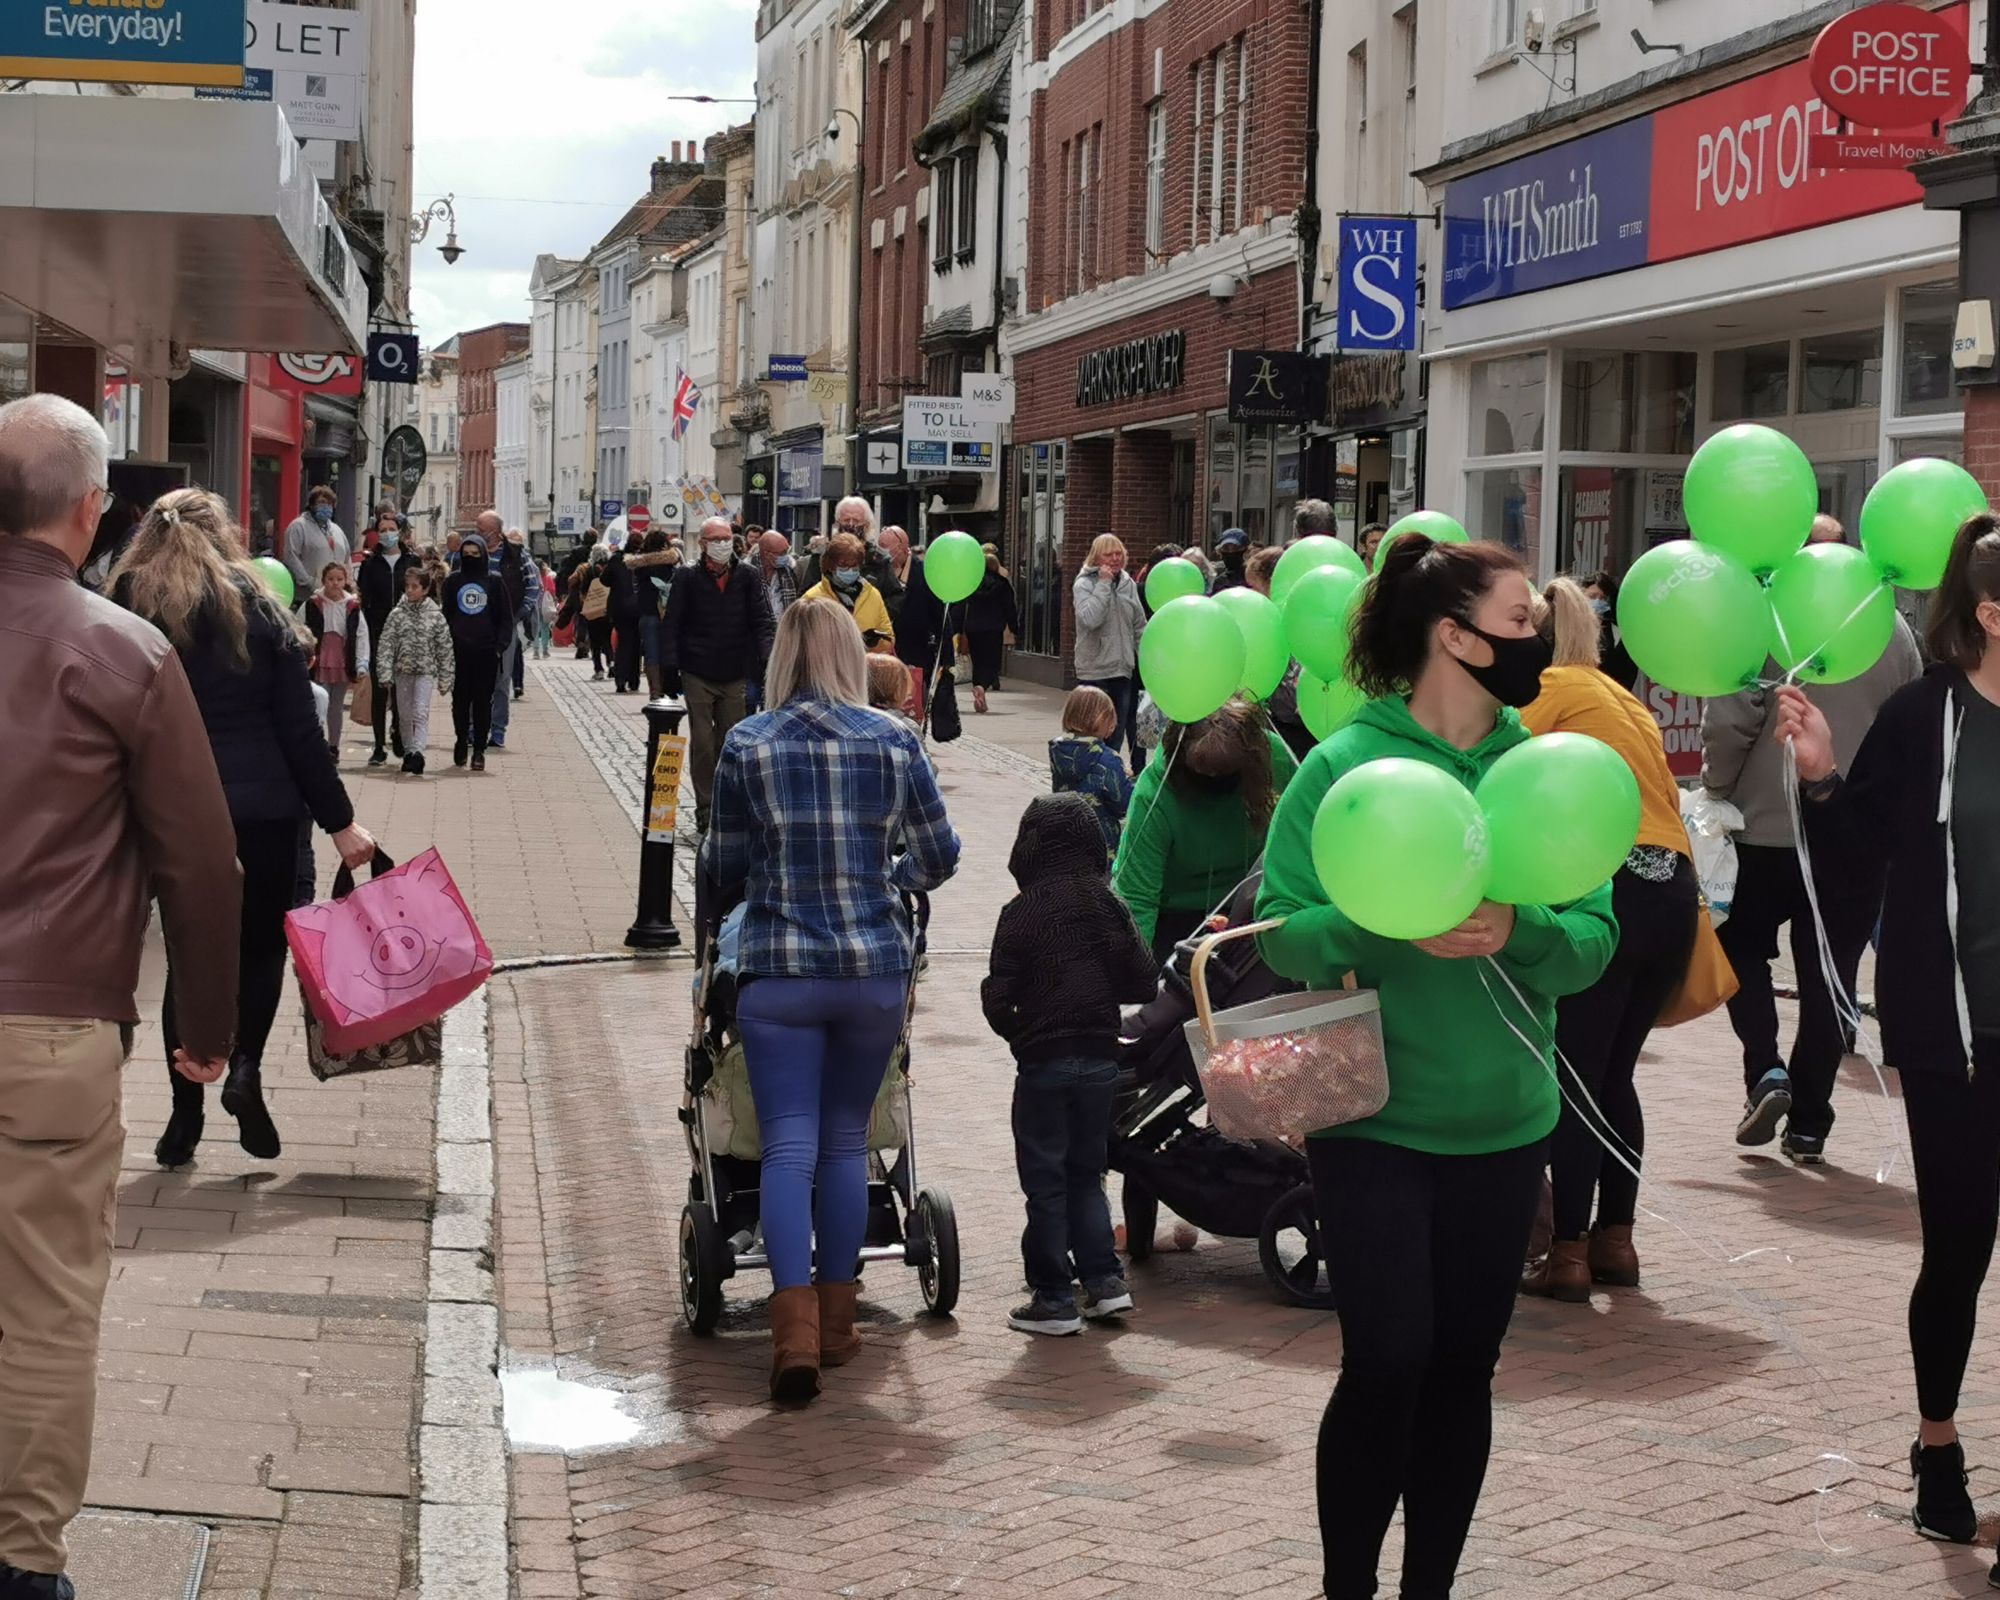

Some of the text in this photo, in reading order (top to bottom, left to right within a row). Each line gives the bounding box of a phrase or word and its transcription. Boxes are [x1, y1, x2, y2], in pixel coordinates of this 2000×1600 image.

[44, 7, 183, 47] Everyday!
[275, 23, 350, 56] LET
[1852, 31, 1939, 61] POST
[1829, 65, 1950, 96] OFFICE
[315, 102, 340, 111] GUNN
[1696, 114, 1772, 211] POST
[1835, 141, 1884, 158] Travel
[1482, 163, 1599, 274] WHSmith
[1352, 228, 1404, 254] WH
[1351, 254, 1405, 341] S
[1122, 328, 1183, 398] SPENCER
[908, 401, 937, 410] FITTED
[973, 389, 1002, 402] M&S
[922, 412, 944, 426] TO
[927, 429, 974, 439] MAY SELL
[560, 504, 589, 514] TO LET
[1648, 685, 1699, 728] SA
[1662, 728, 1703, 754] OW
